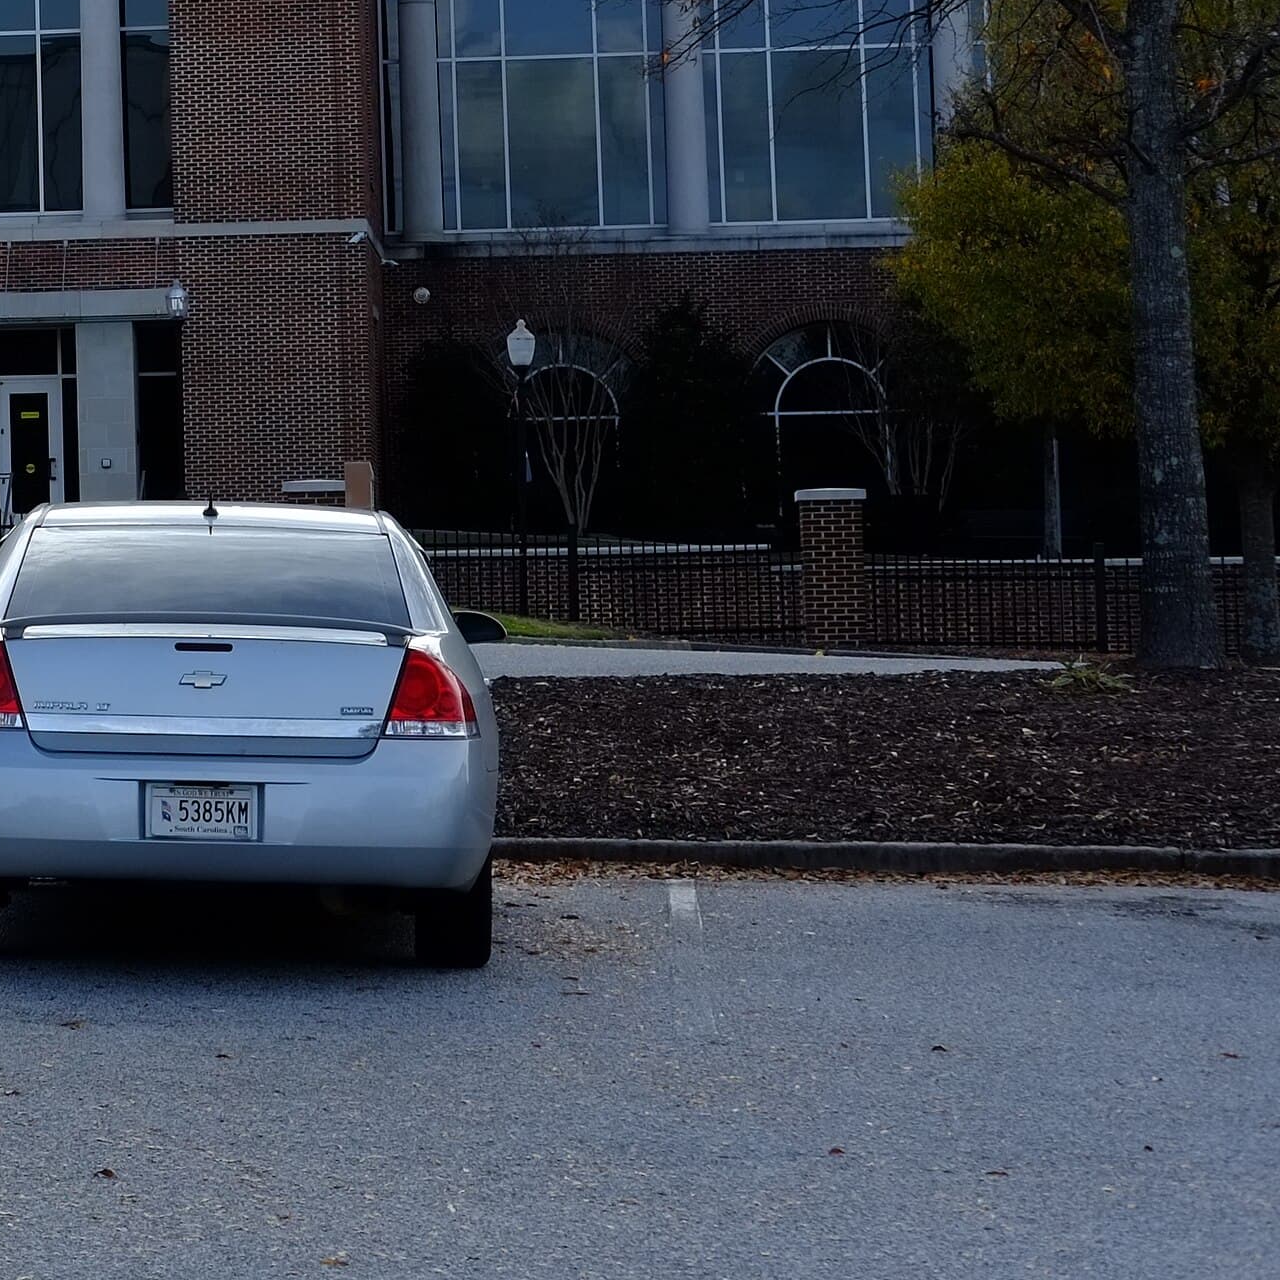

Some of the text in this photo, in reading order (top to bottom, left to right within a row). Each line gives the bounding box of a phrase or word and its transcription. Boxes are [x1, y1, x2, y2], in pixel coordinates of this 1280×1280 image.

[33, 701, 111, 711] IMPALA LT
[179, 799, 249, 824] 5385KM
[174, 825, 195, 833] South
[196, 826, 228, 834] Carolina
